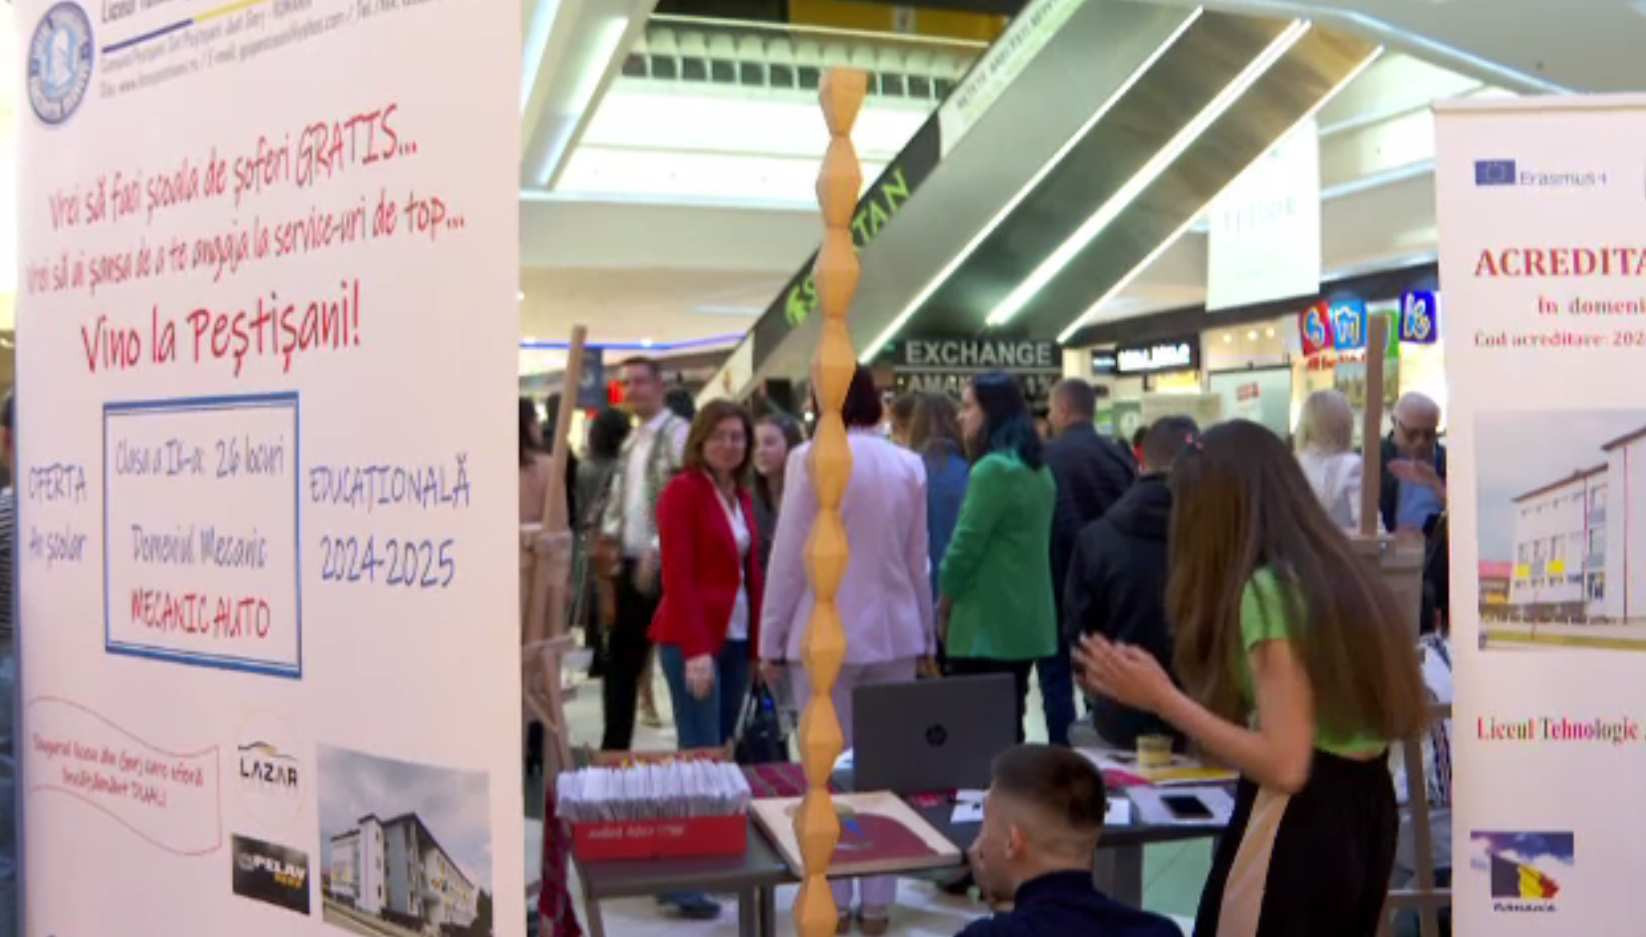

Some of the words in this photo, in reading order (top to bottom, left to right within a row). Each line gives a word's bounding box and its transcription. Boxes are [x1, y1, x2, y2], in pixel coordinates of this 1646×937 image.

[204, 144, 227, 198] de
[234, 134, 290, 209] șoferi
[169, 236, 187, 271] te
[254, 215, 268, 260] la
[274, 195, 367, 255] service-uri
[373, 187, 397, 239] de
[80, 313, 141, 374] Vino
[152, 304, 176, 365] la
[186, 277, 360, 379] Peștișani!
[904, 340, 1054, 366] EXCHANGE
[215, 437, 241, 479] 26
[245, 433, 285, 475] locuri
[29, 462, 88, 504] OFERTA
[309, 452, 471, 514] EDUCAȚIONALĂ
[131, 523, 195, 565] Domeniul
[200, 525, 268, 571] Mecanic
[319, 533, 456, 588] 2024-2025
[130, 588, 210, 636] MECANIC
[213, 596, 272, 640] AUTO
[1477, 716, 1535, 740] Liceul
[1540, 715, 1639, 747] Tehnologic
[239, 757, 298, 787] LAZAR
